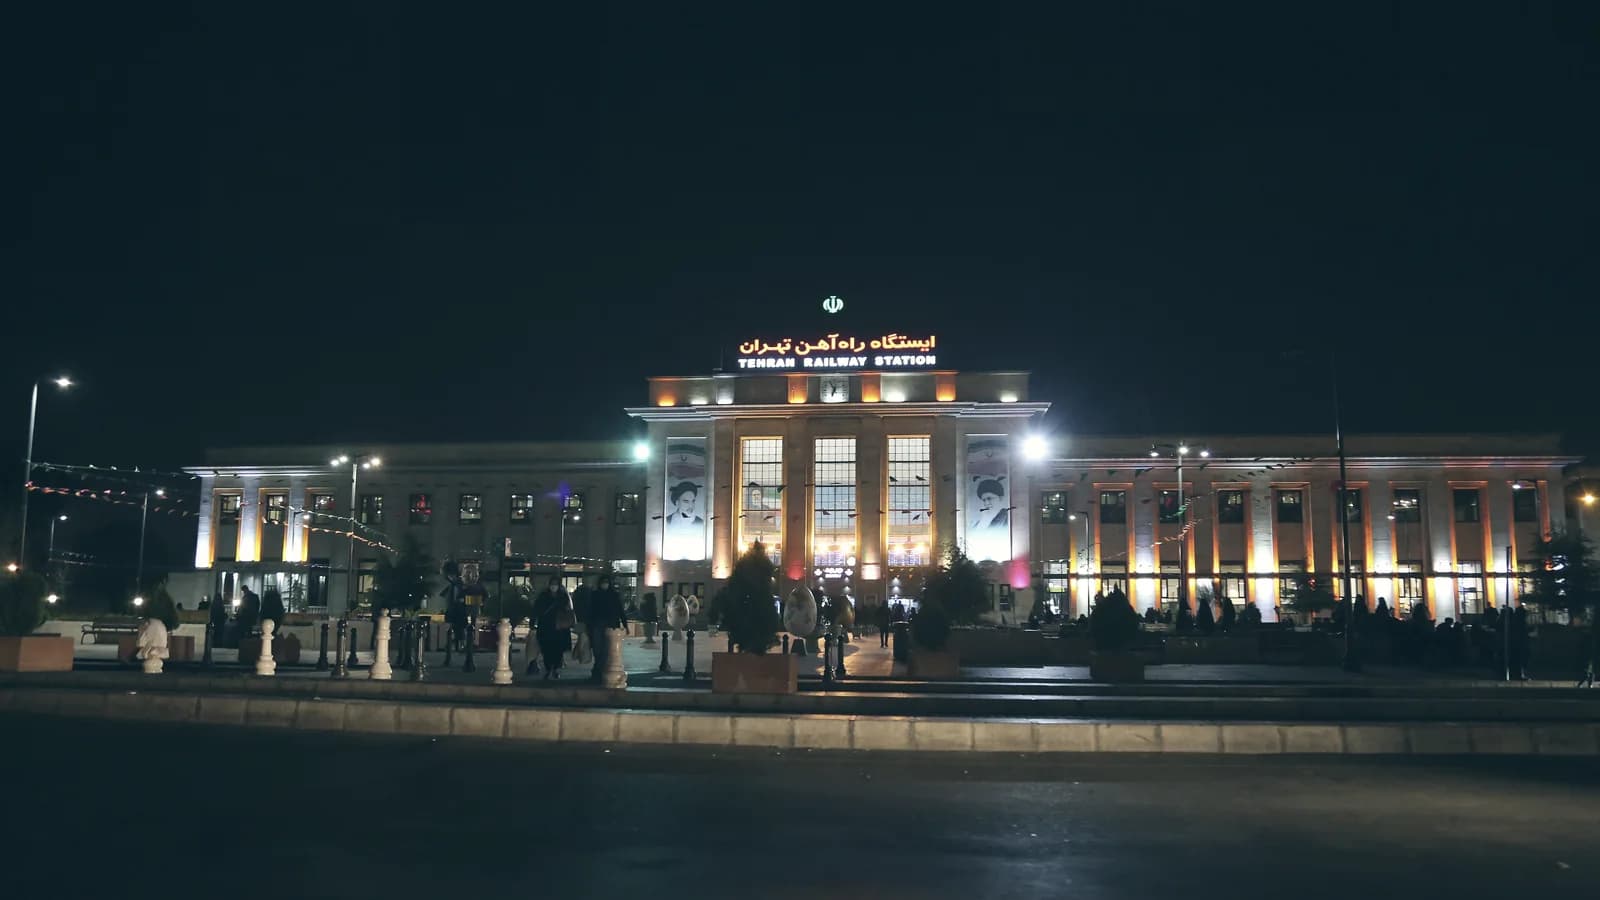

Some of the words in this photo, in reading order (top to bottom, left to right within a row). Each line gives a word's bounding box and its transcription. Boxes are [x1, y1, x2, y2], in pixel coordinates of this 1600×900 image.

[739, 338, 792, 355] تهران
[870, 333, 936, 352] ایستگاه
[737, 357, 796, 369] TEHRAN
[803, 356, 868, 368] RAILWAY
[874, 355, 936, 367] STATION
